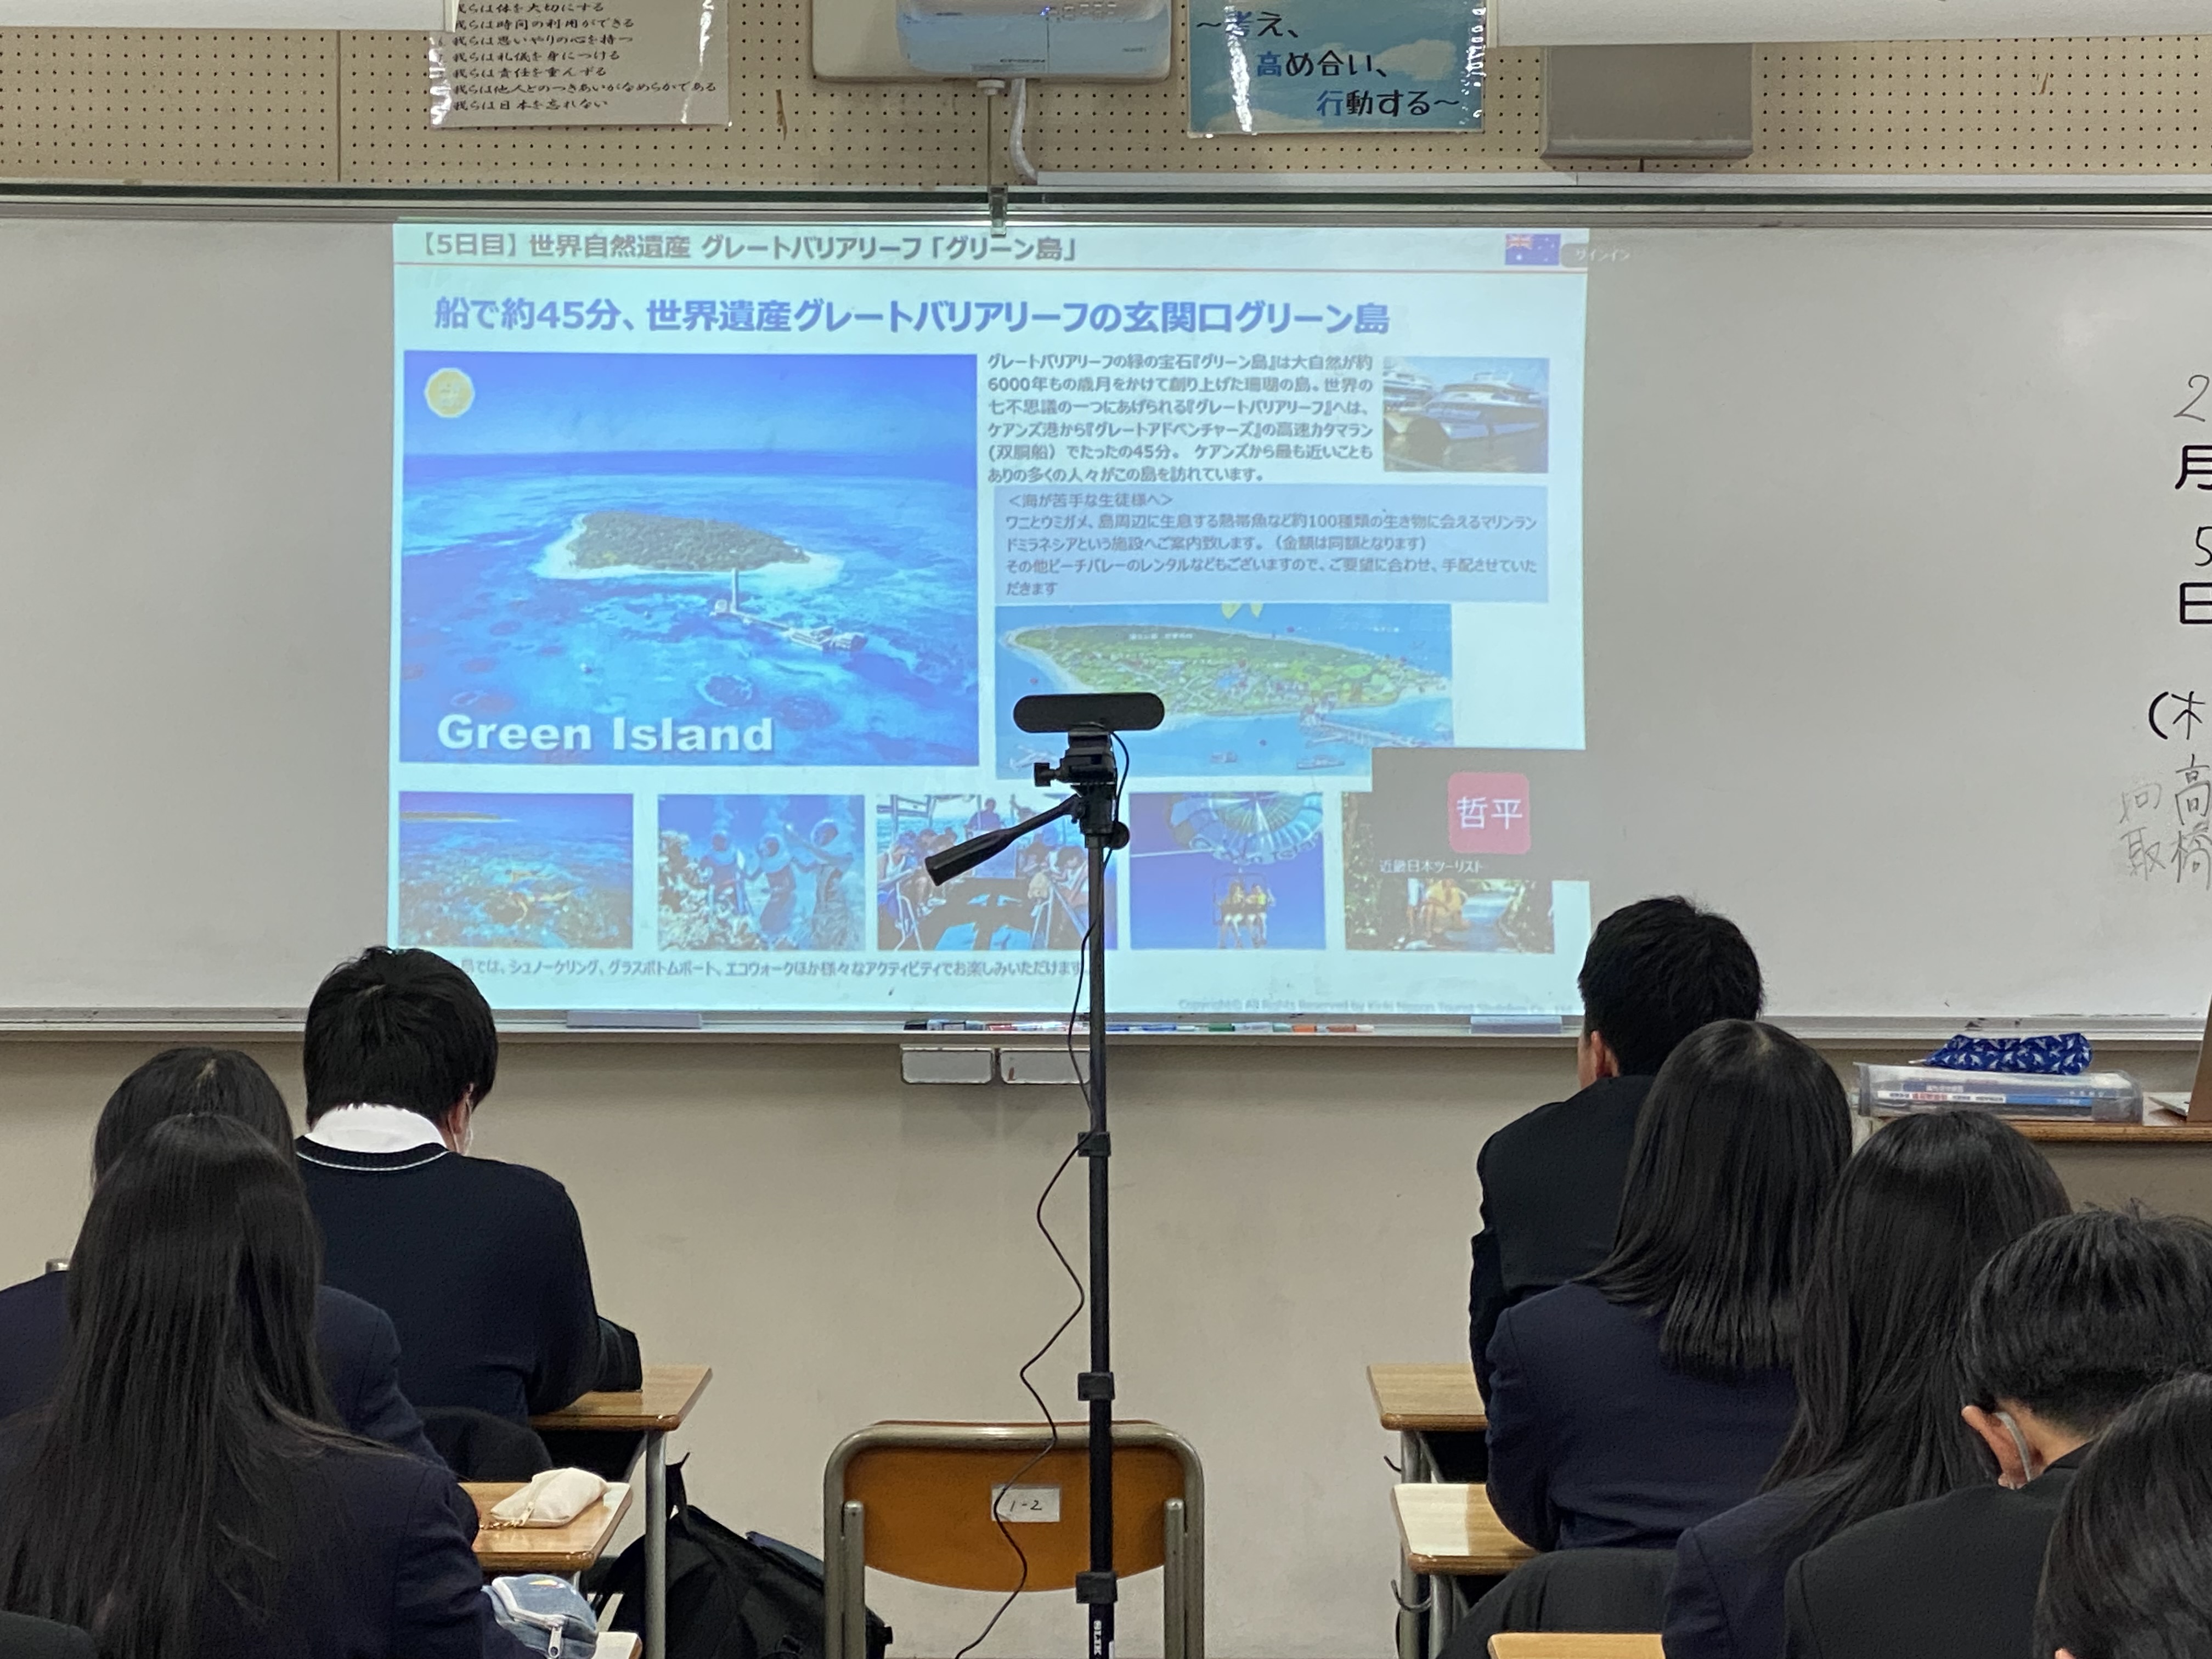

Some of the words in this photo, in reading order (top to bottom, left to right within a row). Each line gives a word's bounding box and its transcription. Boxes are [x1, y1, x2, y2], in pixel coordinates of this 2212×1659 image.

[1257, 50, 1387, 77] 高め合い、
[435, 296, 1391, 335] 船で約45分、世界遺産グレートバリアリーフの玄関口グリーン島
[1006, 582, 1058, 596] だきます
[437, 713, 592, 751] Green
[612, 716, 774, 752] Island
[1456, 796, 1523, 830] 哲平
[1010, 1499, 1042, 1512] 1-2
